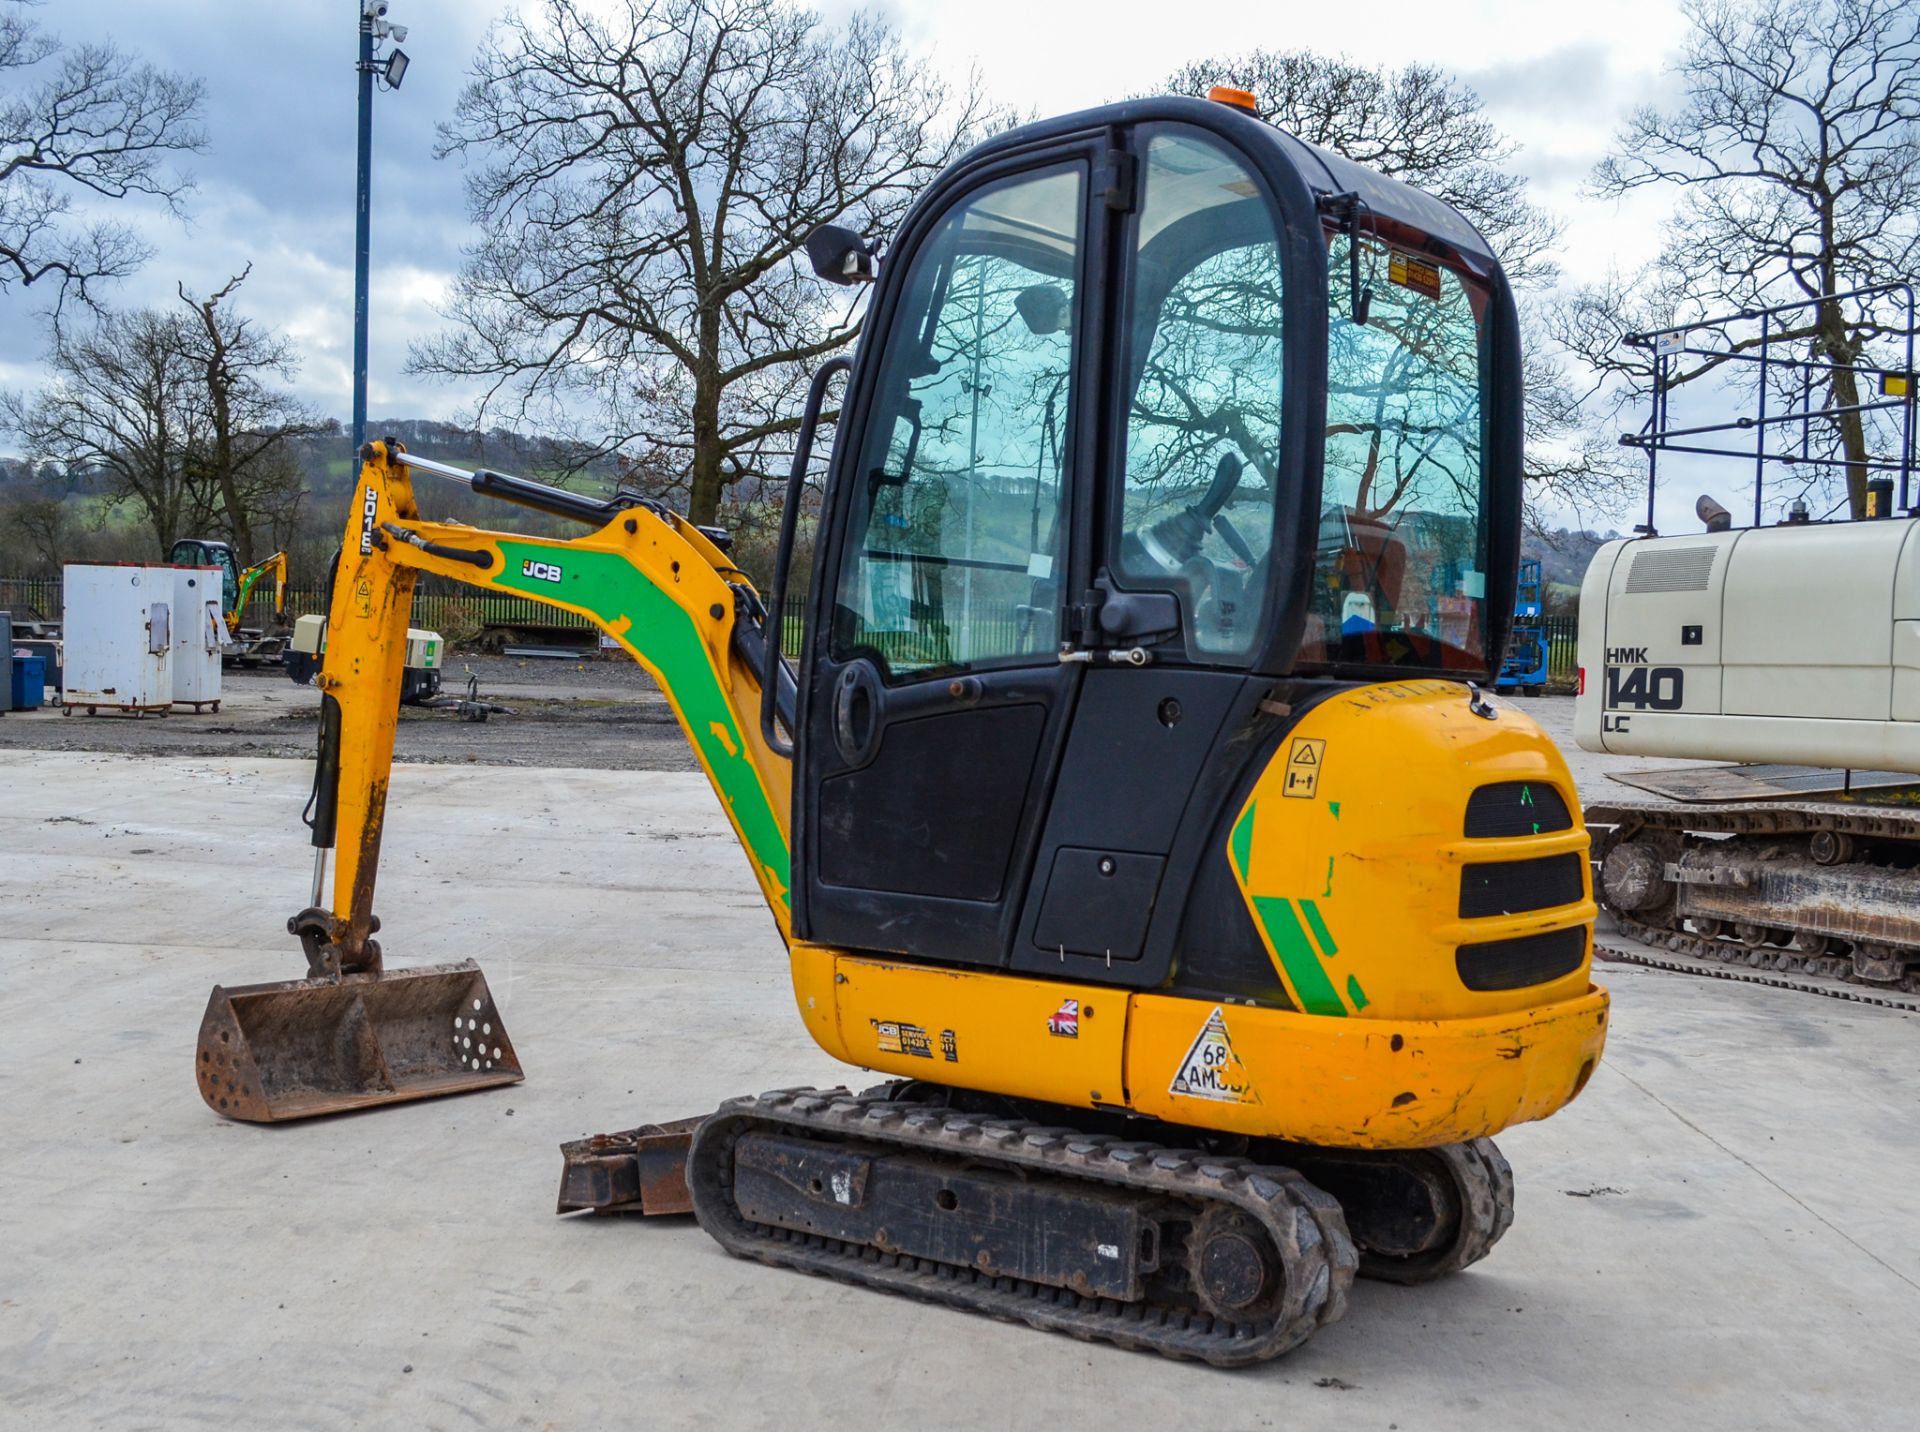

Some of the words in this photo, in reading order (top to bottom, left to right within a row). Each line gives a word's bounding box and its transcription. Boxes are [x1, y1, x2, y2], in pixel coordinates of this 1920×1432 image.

[522, 561, 561, 582] JCB
[1606, 648, 1648, 663] HMK
[1608, 667, 1684, 710] 140
[1604, 715, 1630, 733] LC
[1203, 1044, 1226, 1066] 68
